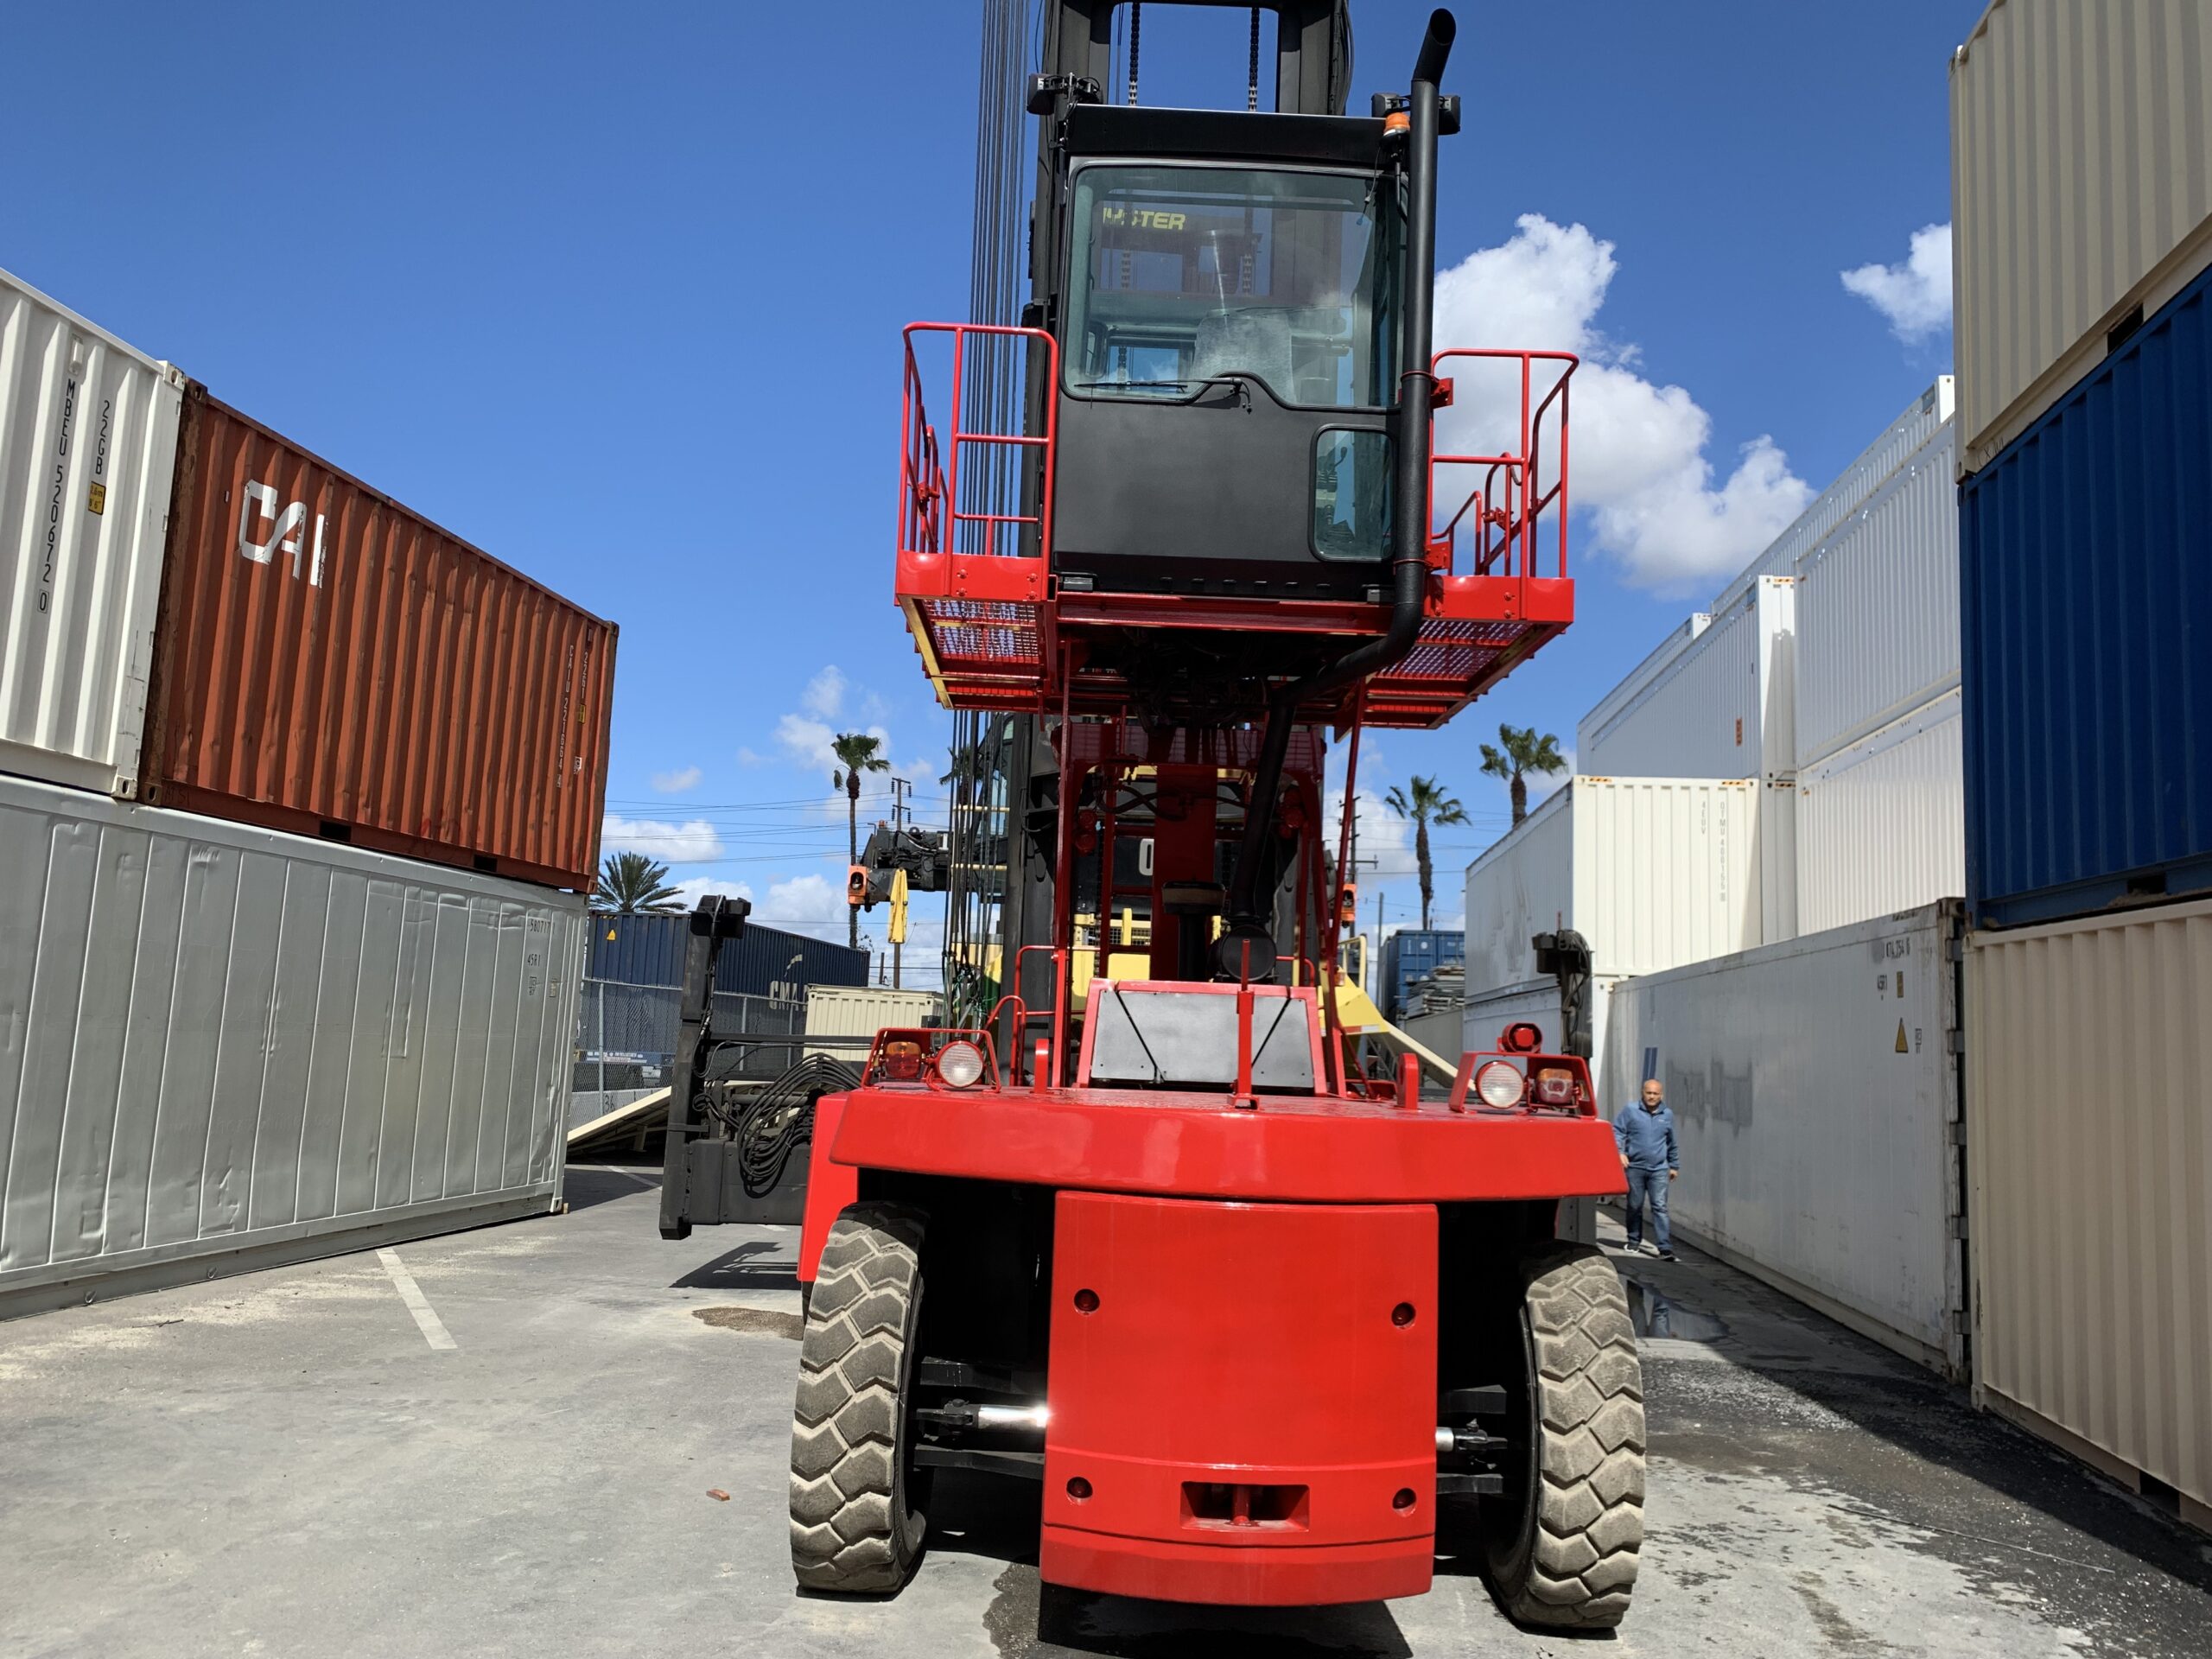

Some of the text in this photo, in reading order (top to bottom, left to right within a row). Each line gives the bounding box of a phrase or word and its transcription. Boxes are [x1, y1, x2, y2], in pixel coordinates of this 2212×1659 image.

[58, 378, 76, 456] MBEU
[96, 400, 110, 474] 22GB
[41, 465, 63, 583] 520672
[239, 480, 327, 588] CAI
[769, 981, 798, 1011] CMA
